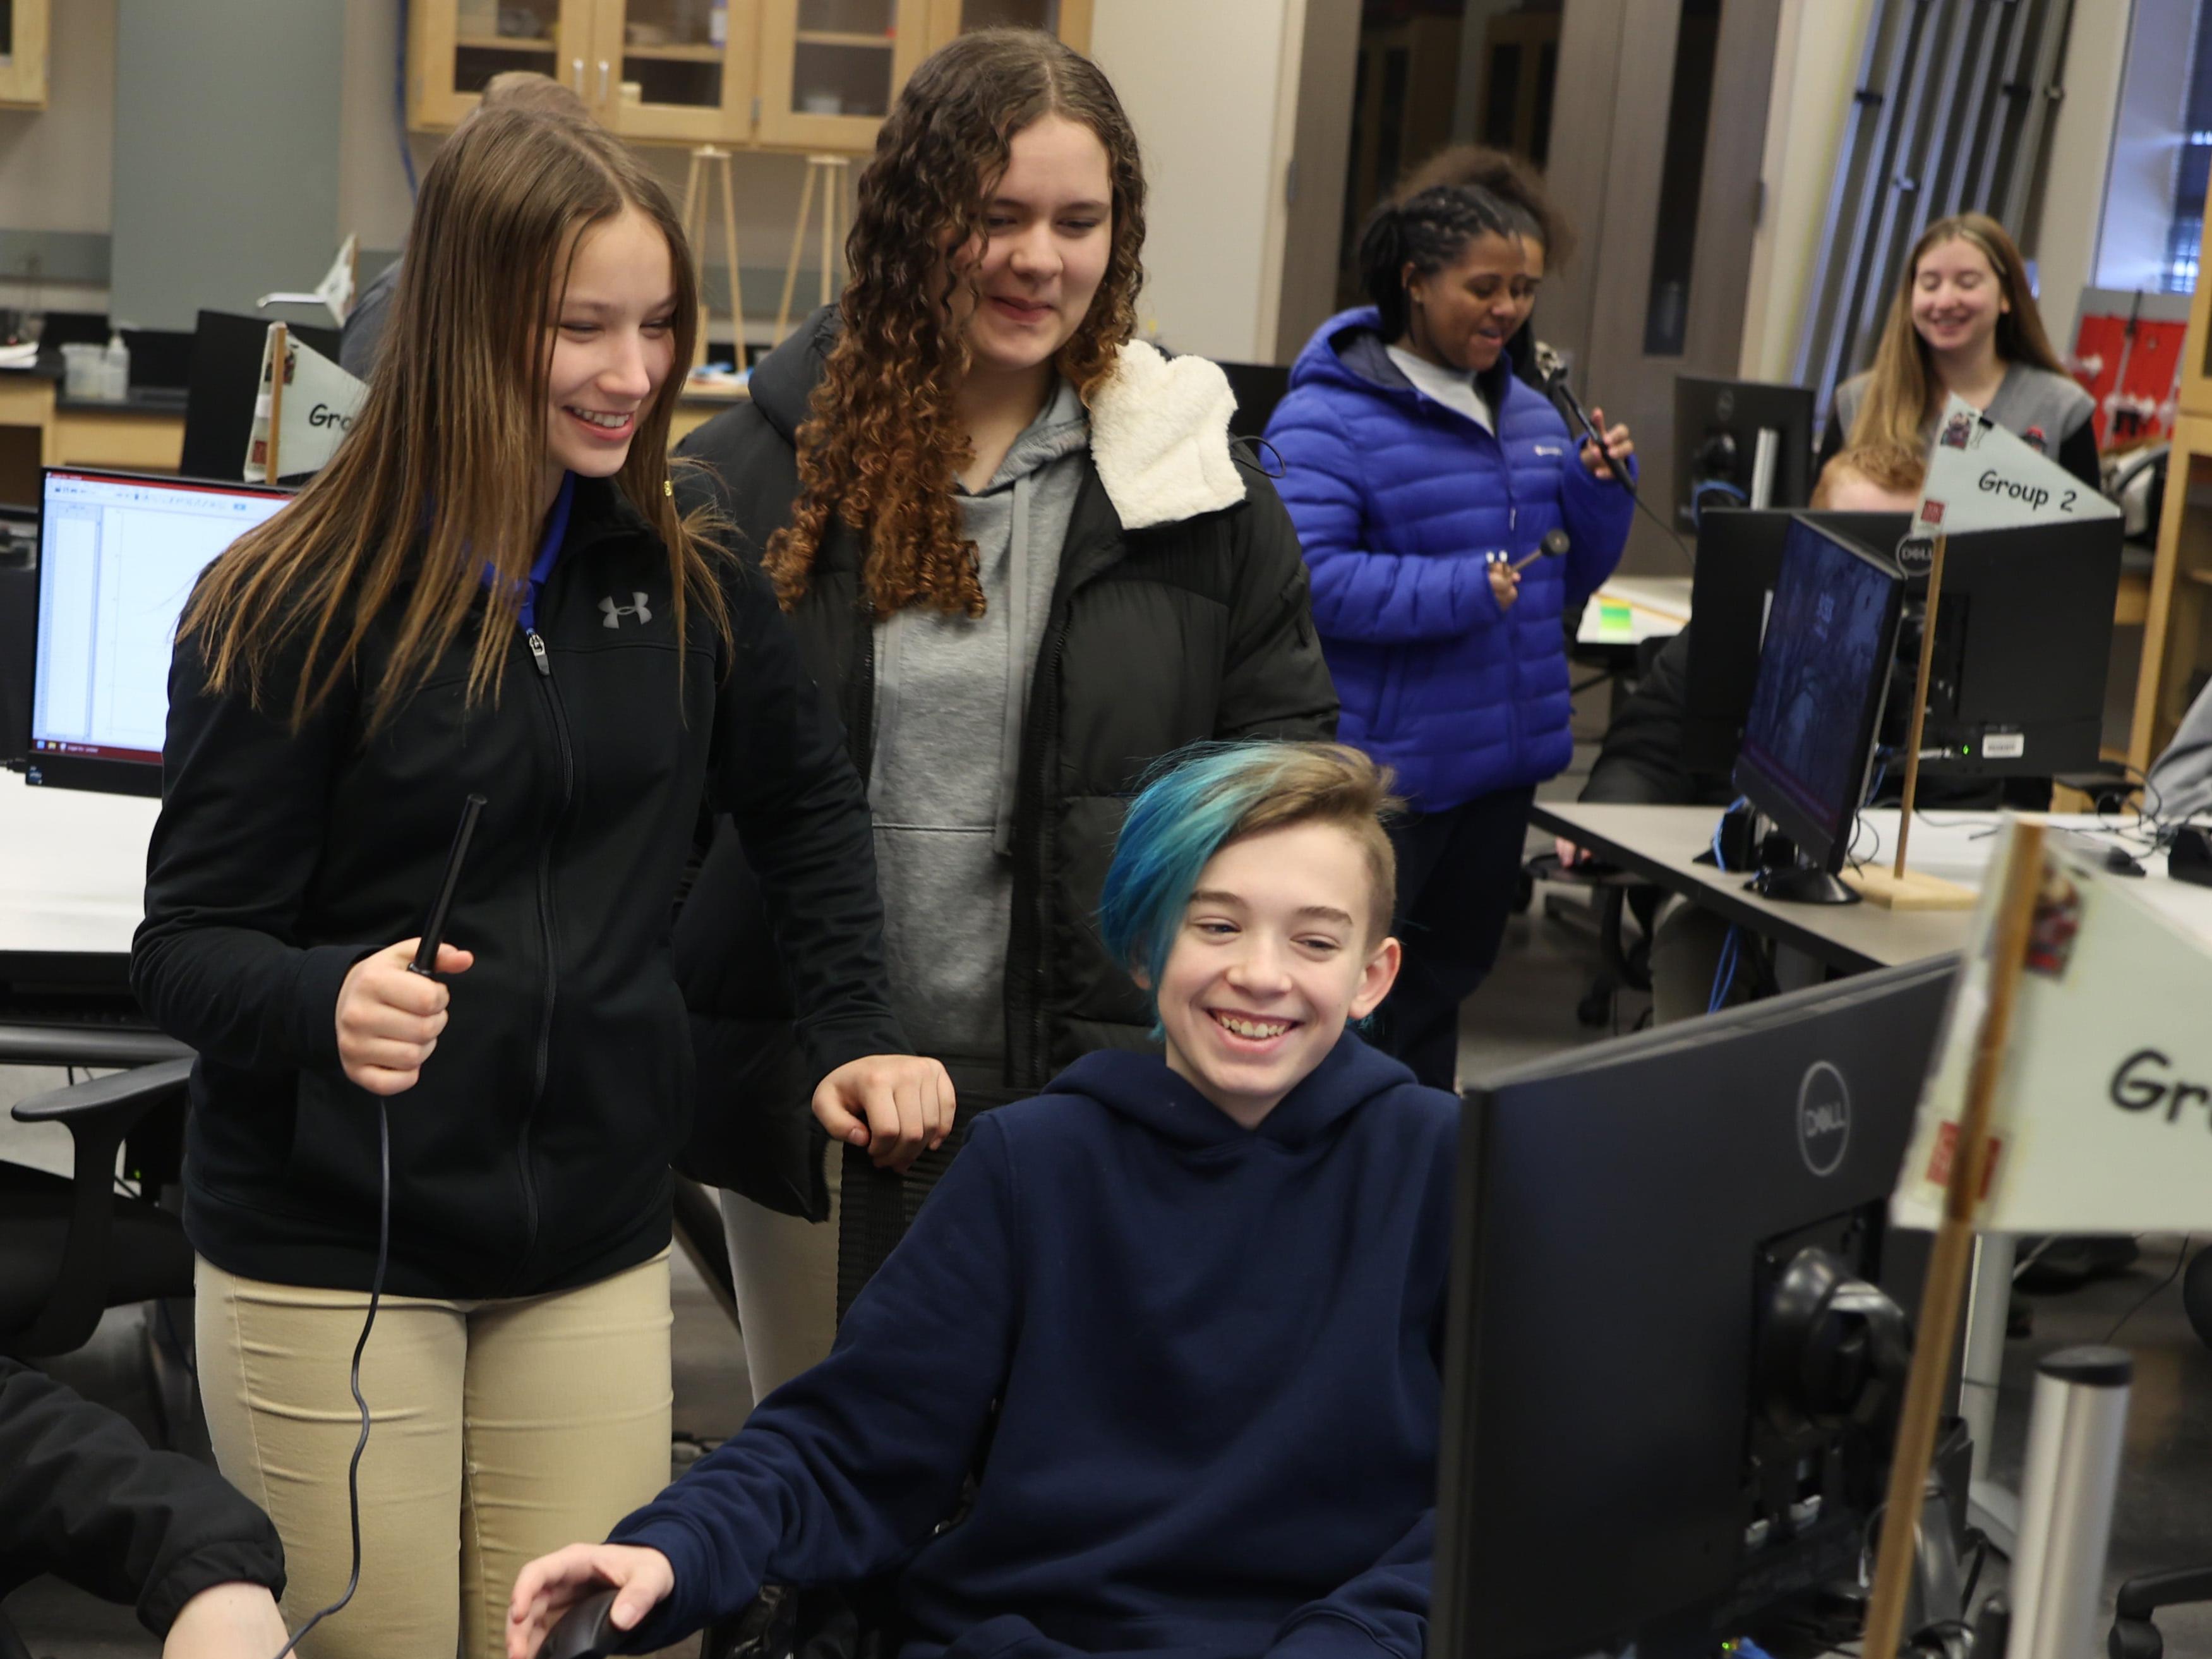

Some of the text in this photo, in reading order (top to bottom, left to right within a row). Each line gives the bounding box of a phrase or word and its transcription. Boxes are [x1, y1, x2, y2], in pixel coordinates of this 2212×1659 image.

[1978, 470, 2077, 512] Group 2
[2110, 1048, 2212, 1132] Gr
[1805, 1102, 1846, 1137] DELL
